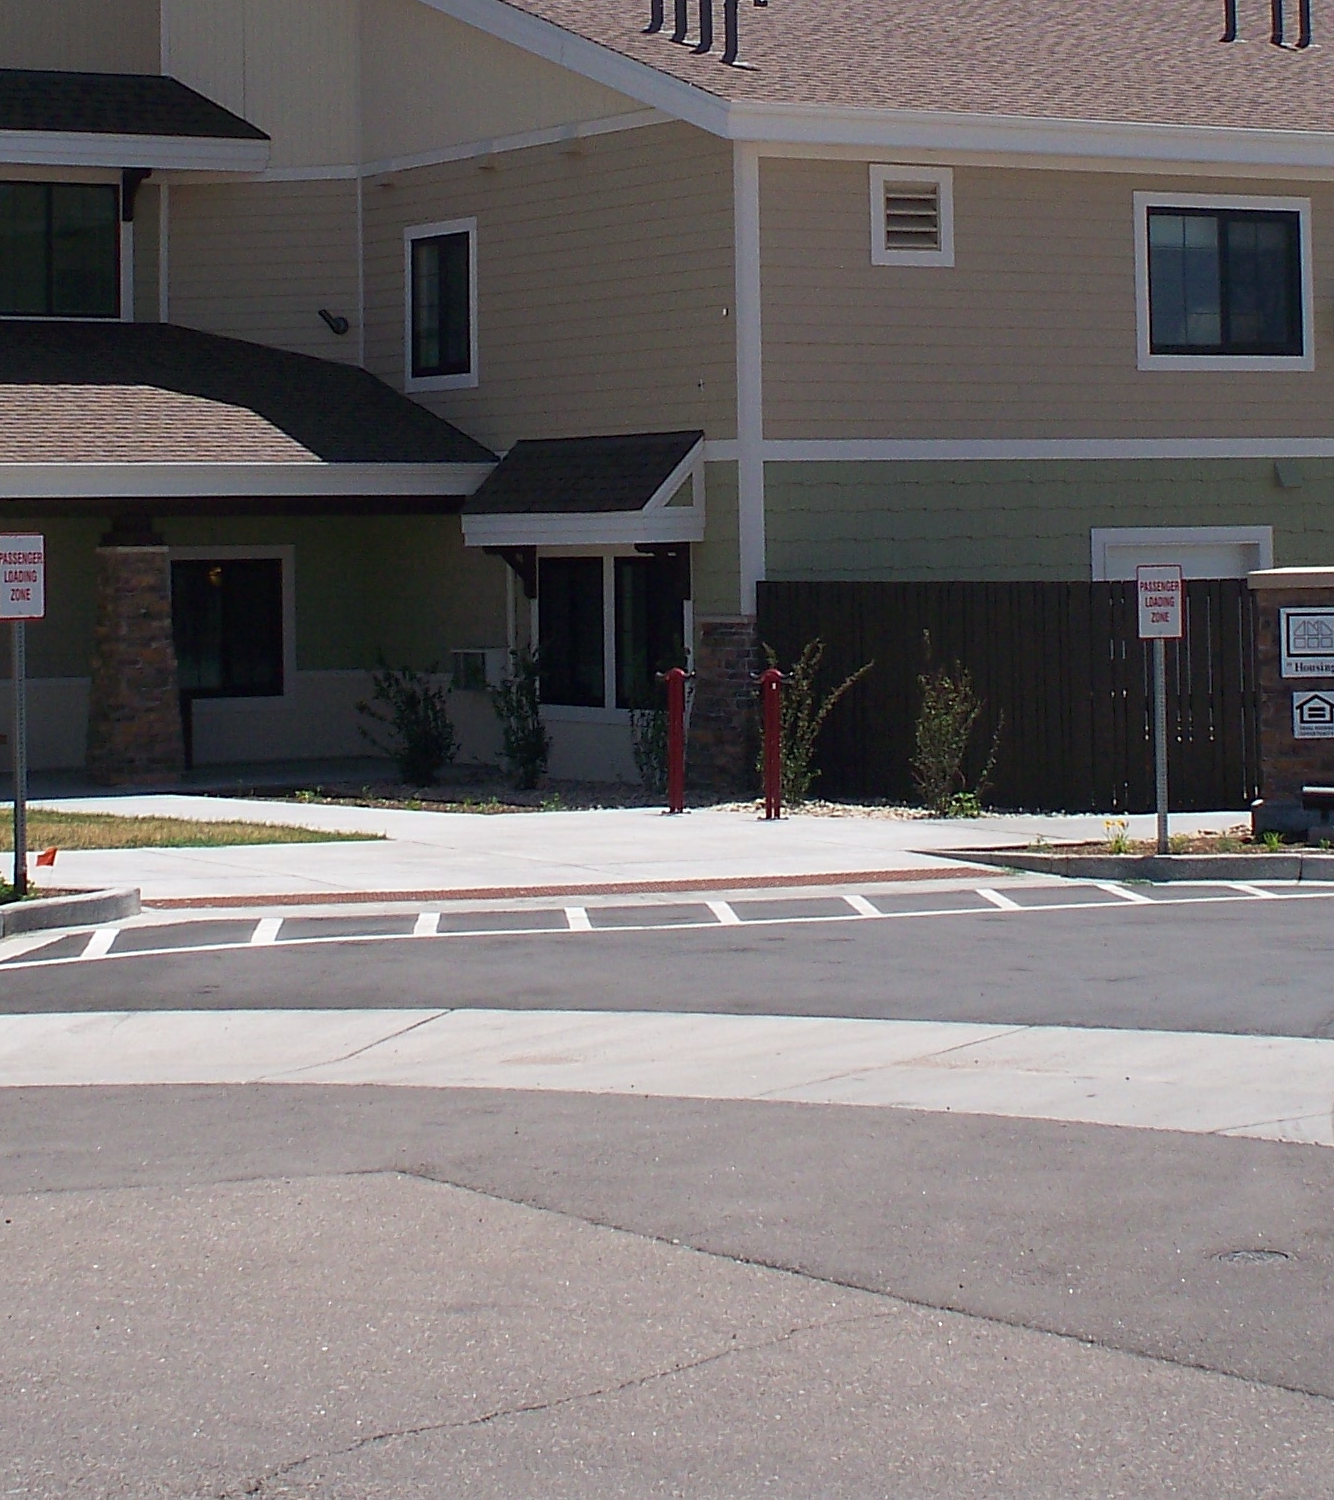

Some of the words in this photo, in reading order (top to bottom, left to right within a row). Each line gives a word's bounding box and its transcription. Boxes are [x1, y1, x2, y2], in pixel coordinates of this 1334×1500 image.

[4, 570, 38, 583] LOADING
[1139, 581, 1180, 592] PASSENGER
[10, 588, 32, 601] ZONE
[1145, 596, 1175, 608] LOADING
[1151, 611, 1170, 623] ZONE
